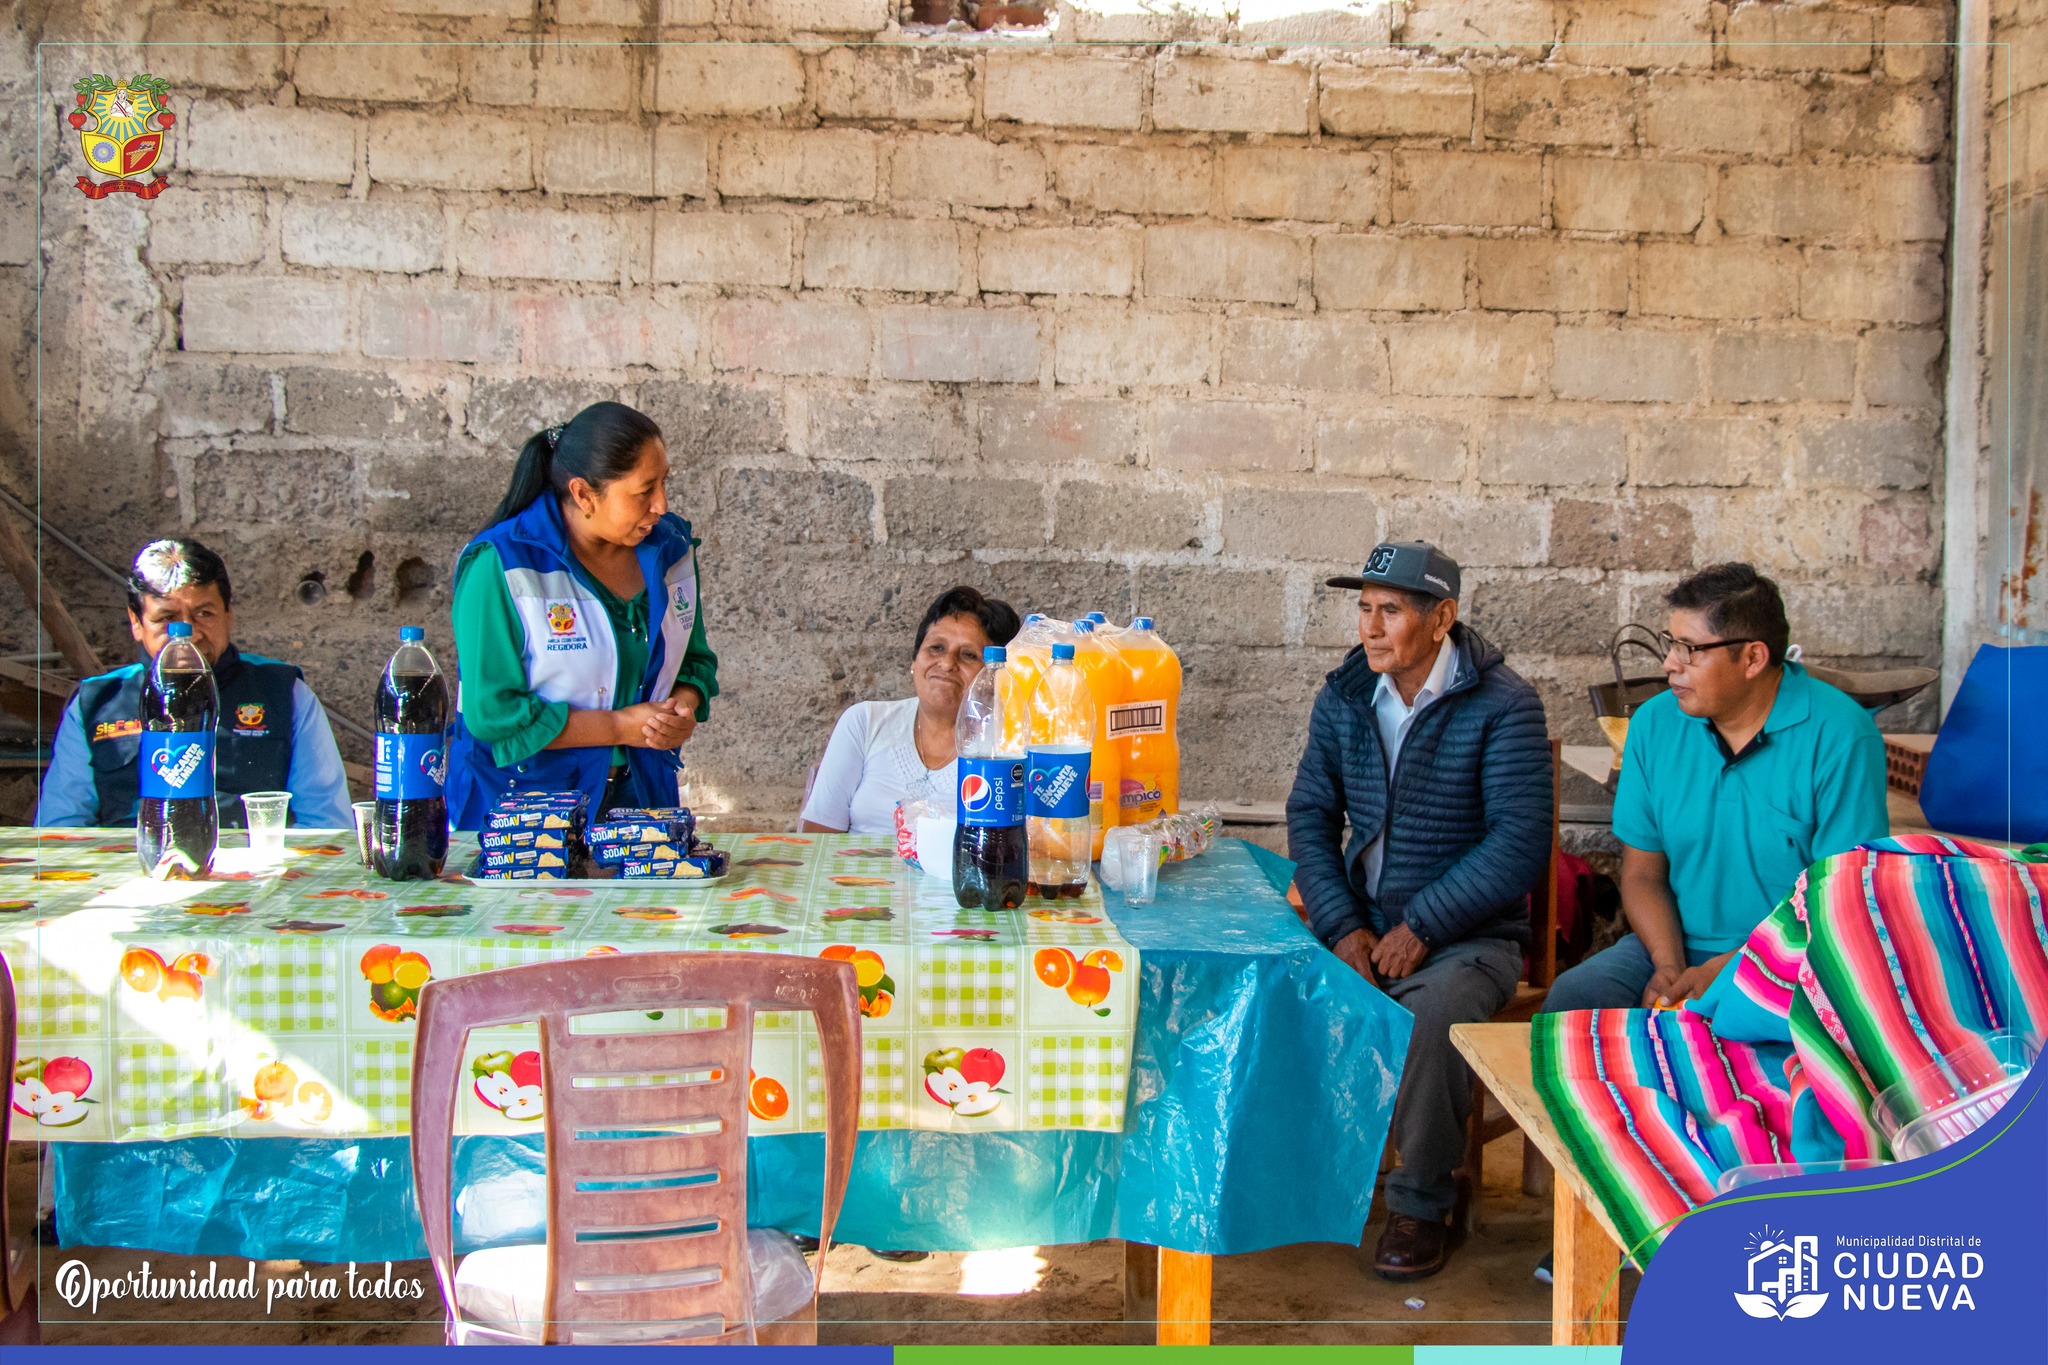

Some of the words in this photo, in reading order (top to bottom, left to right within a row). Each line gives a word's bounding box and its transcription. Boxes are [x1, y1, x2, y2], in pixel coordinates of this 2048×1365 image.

[547, 643, 588, 651] REGIDORA
[157, 764, 171, 778] TE
[164, 742, 201, 786] ENCANTA
[1033, 784, 1045, 797] TE
[1039, 764, 1074, 804] ENCANTA
[993, 777, 1005, 811] pepsi
[1119, 790, 1162, 806] mpico
